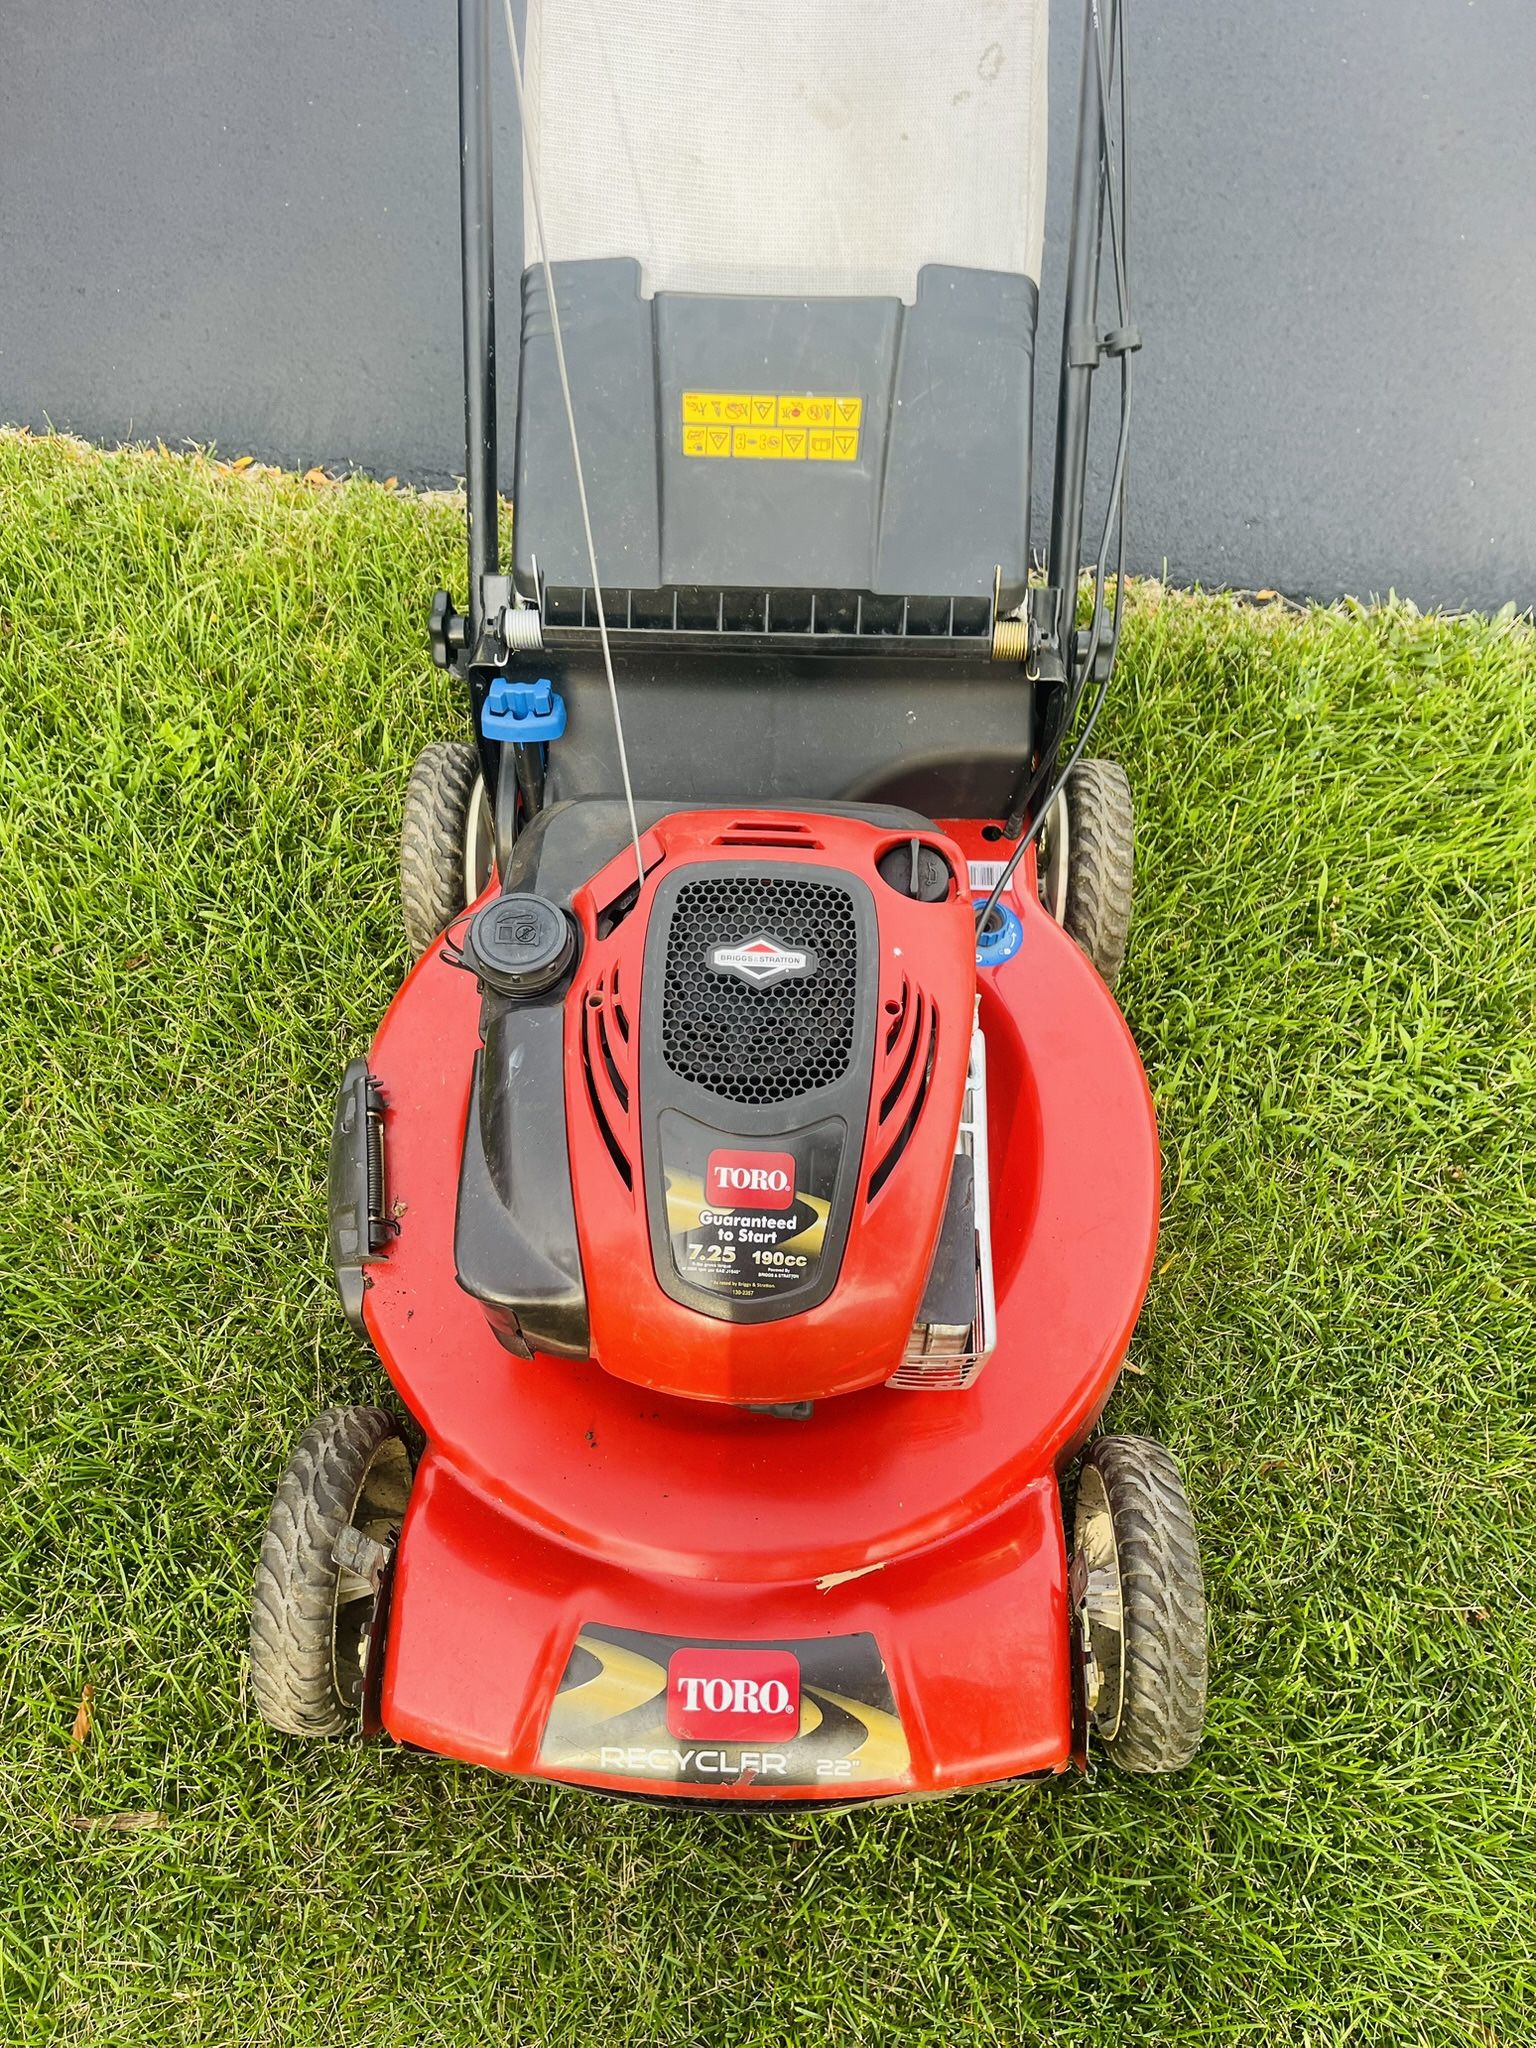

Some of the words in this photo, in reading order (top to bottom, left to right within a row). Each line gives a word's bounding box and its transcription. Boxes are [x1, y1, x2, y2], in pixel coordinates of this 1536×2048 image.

[720, 954, 753, 963] BRIGGS
[759, 955, 800, 964] STRATTON
[699, 1210, 797, 1230] Guaranteed
[718, 1228, 734, 1242] to
[738, 1228, 777, 1244] Start
[688, 1243, 737, 1263] 7.25
[751, 1250, 808, 1267] 190cc
[600, 1746, 788, 1775] RECYCLER
